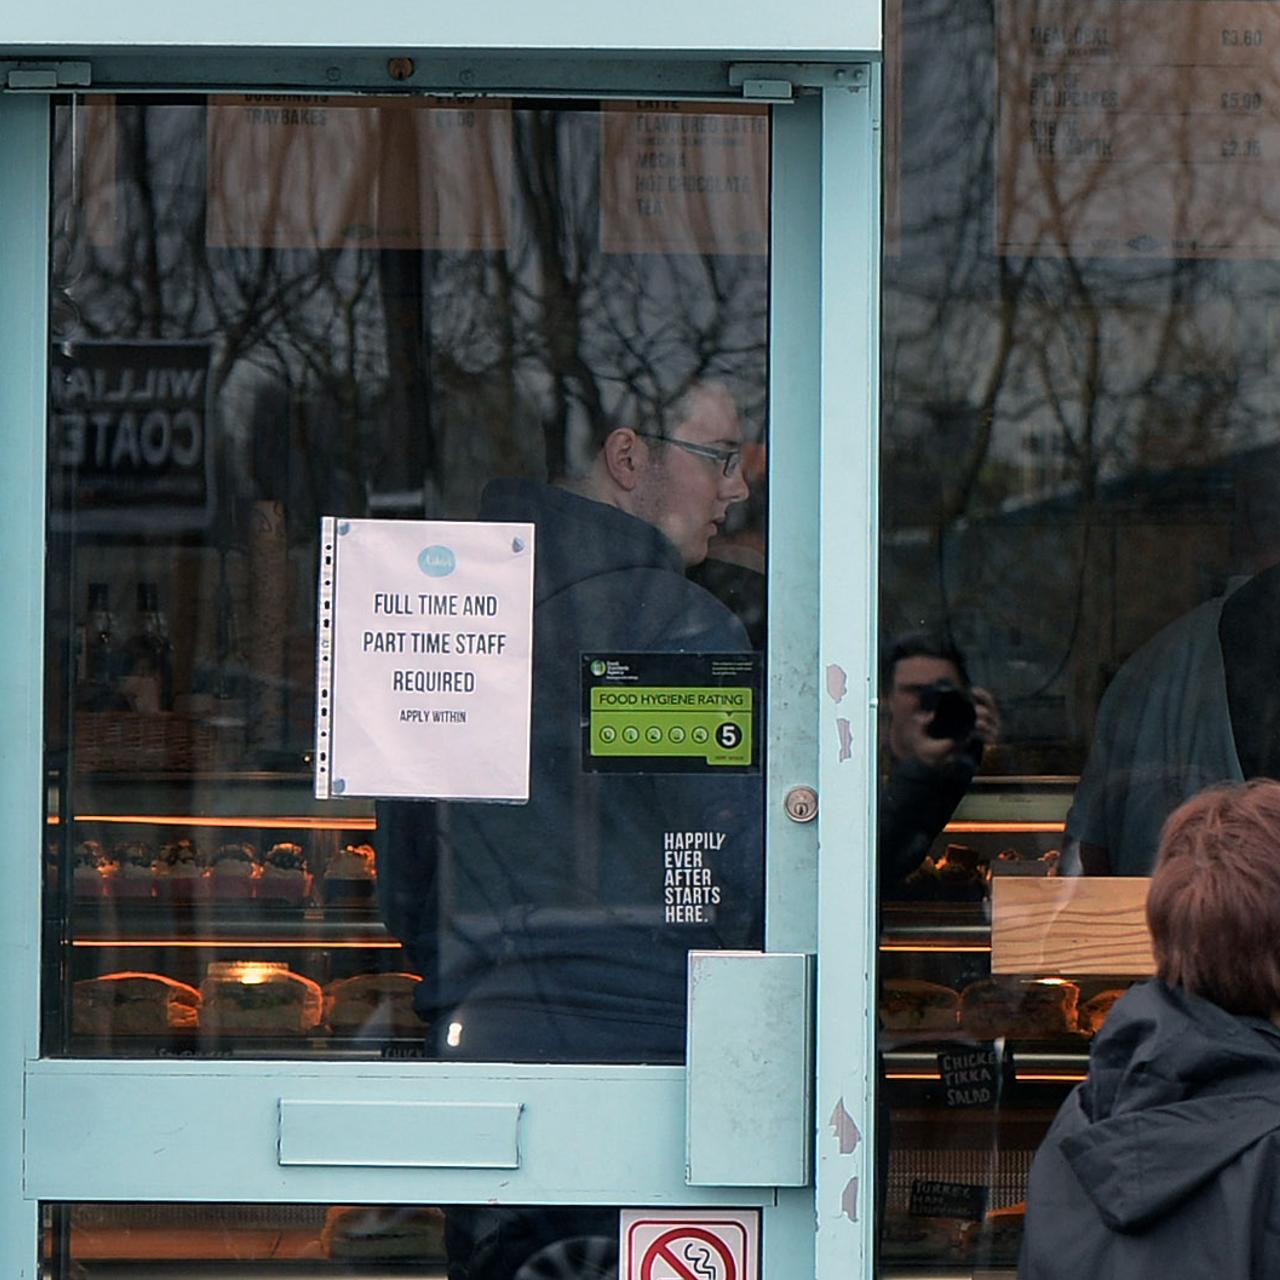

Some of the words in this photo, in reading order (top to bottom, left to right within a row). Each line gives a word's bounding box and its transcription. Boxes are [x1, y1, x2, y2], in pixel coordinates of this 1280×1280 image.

[374, 593, 413, 615] FULL
[418, 594, 458, 616] TIME
[463, 595, 498, 616] AND
[363, 632, 406, 653] PART
[411, 633, 451, 654] TIME
[455, 634, 508, 655] STAFF
[393, 671, 476, 693] REQUIRED
[600, 694, 638, 706] FOOD
[641, 694, 695, 706] HYGIENE
[698, 694, 744, 706] RATING
[400, 709, 430, 723] APPLY
[433, 710, 467, 723] WITHIN
[721, 725, 737, 746] 5
[664, 832, 726, 850] HAPPILY
[664, 850, 703, 868] EVER
[664, 869, 712, 887] AFTER
[664, 886, 721, 905] STARTS
[665, 905, 709, 924] HERE.
[944, 1068, 992, 1086] TIKKA
[947, 1087, 990, 1106] SALAD
